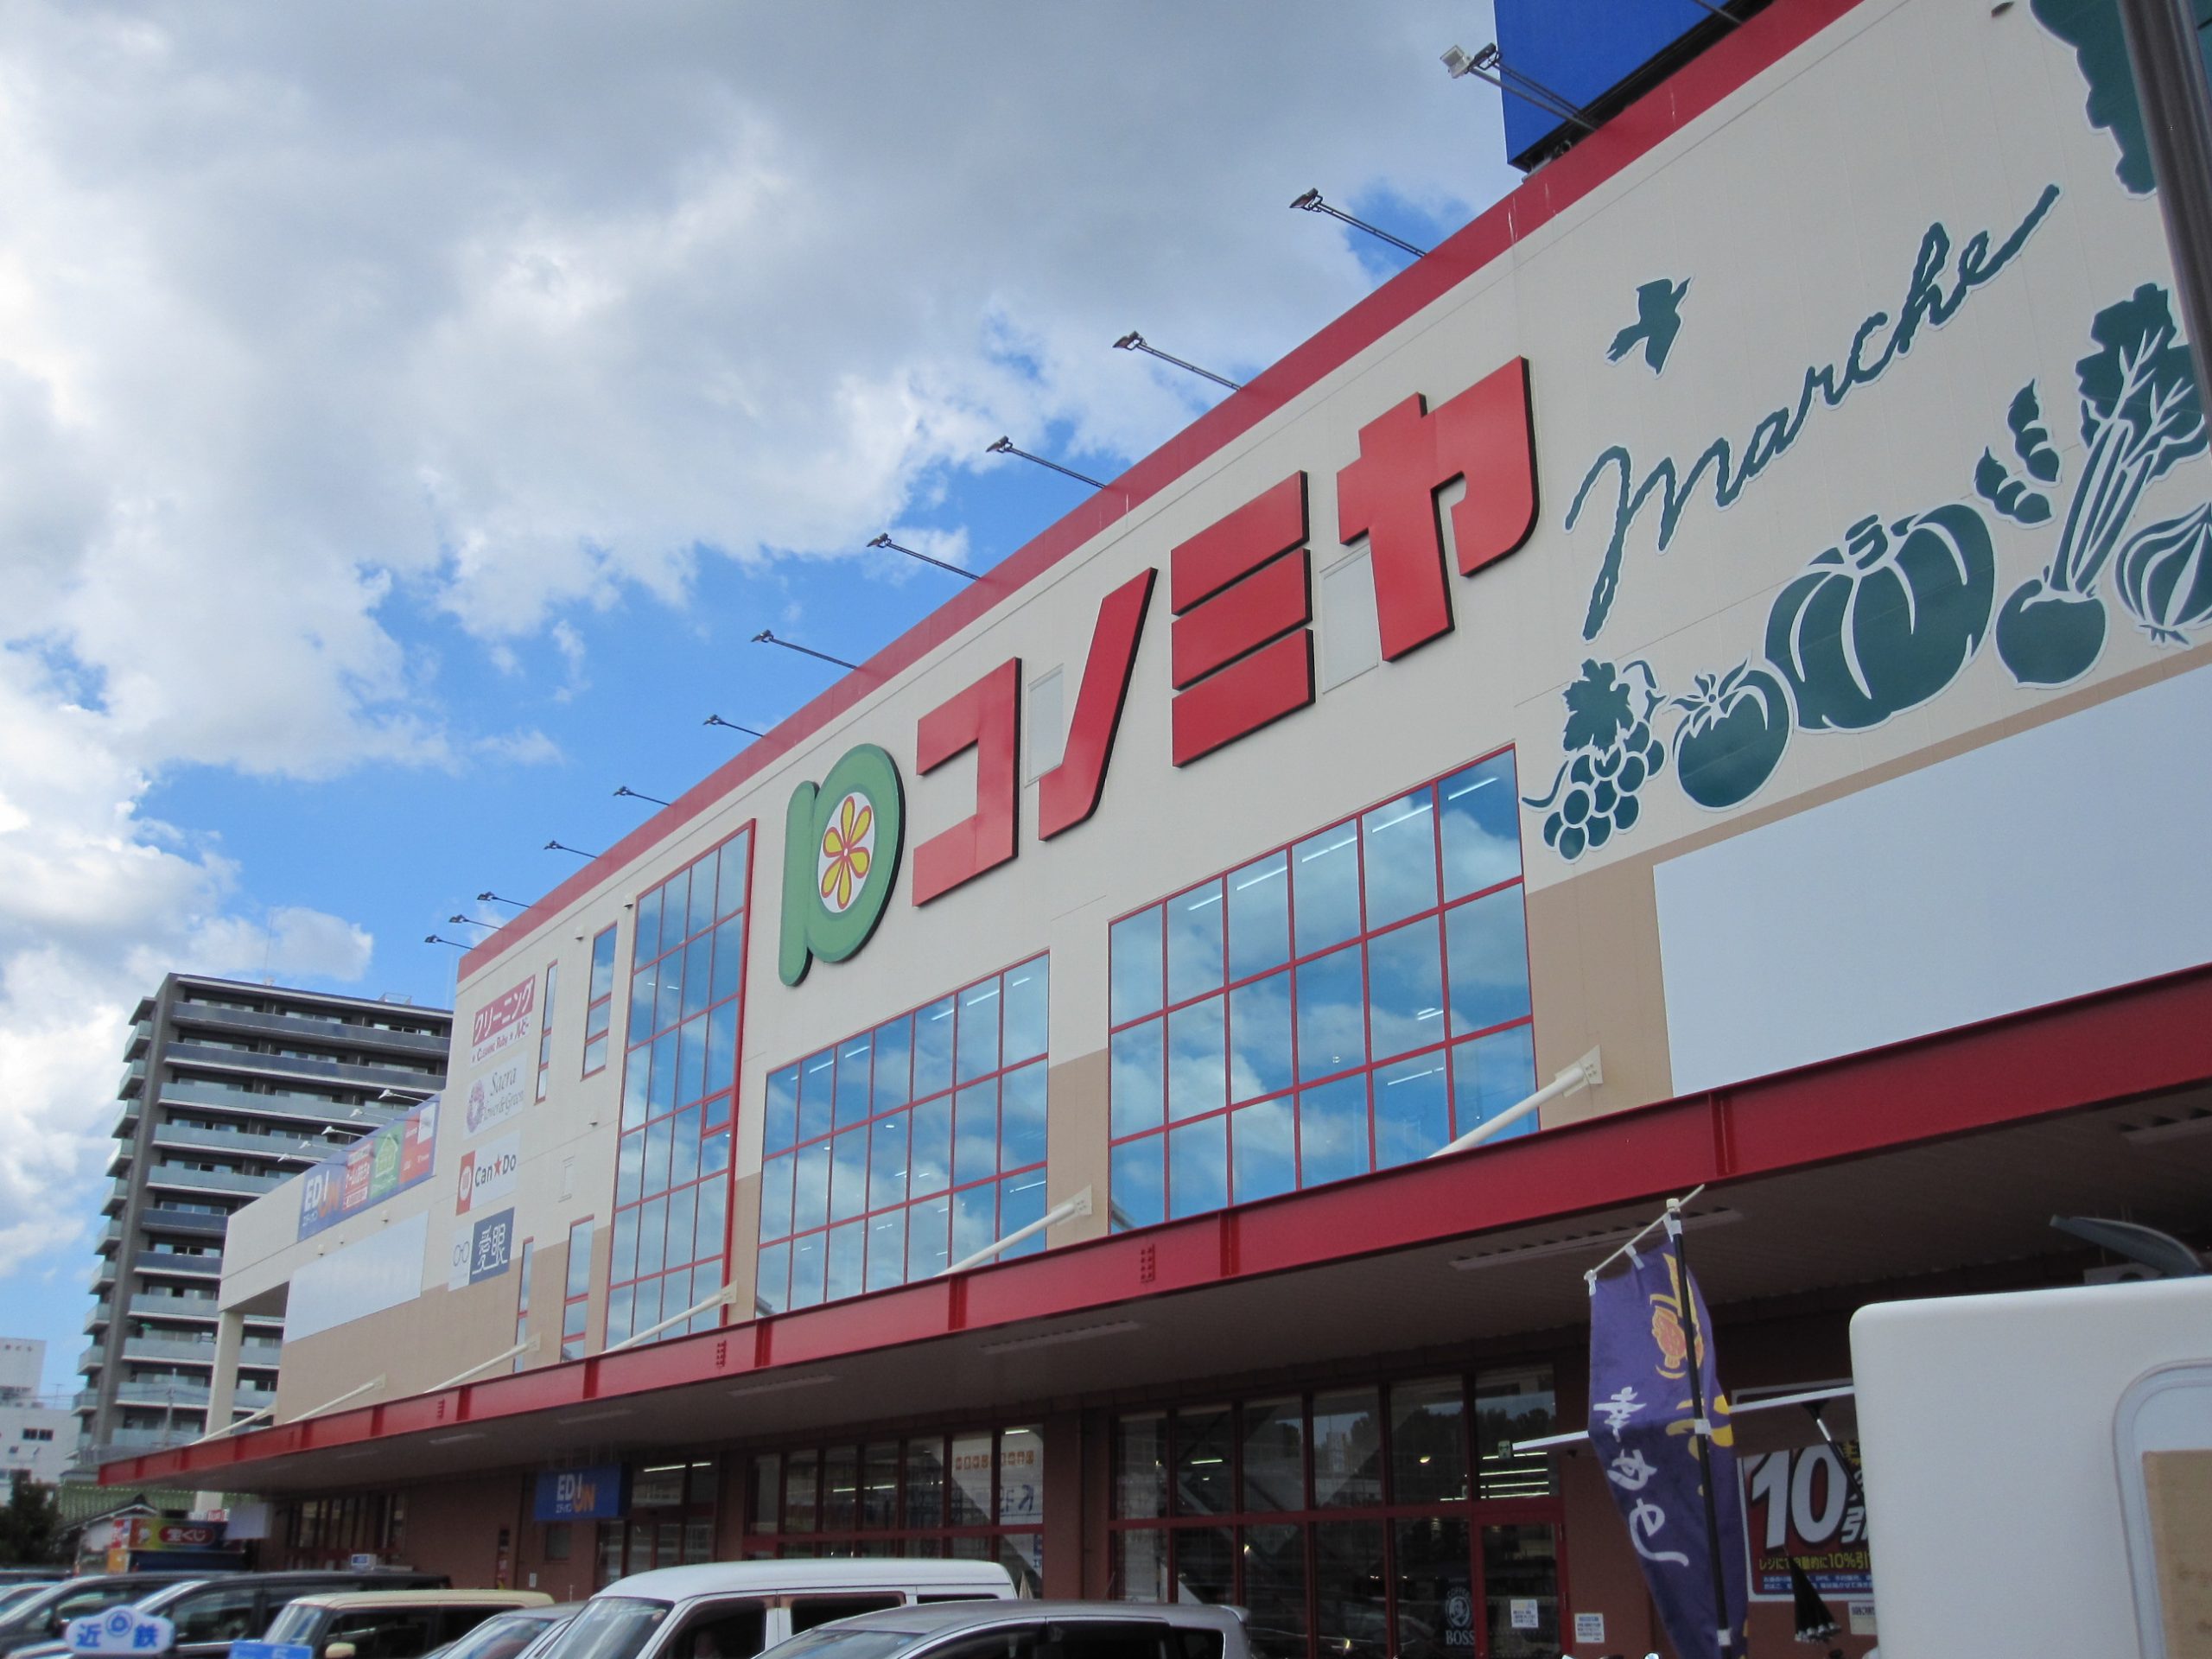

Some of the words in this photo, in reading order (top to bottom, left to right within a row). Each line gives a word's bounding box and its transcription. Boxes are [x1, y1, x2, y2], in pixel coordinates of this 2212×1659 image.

[912, 355, 1541, 908] コノミヤ
[474, 977, 533, 1044] クリーニング
[472, 1223, 508, 1275] 愛眼
[167, 1528, 207, 1542] 宝くじ
[1446, 1629, 1476, 1646] BOSS
